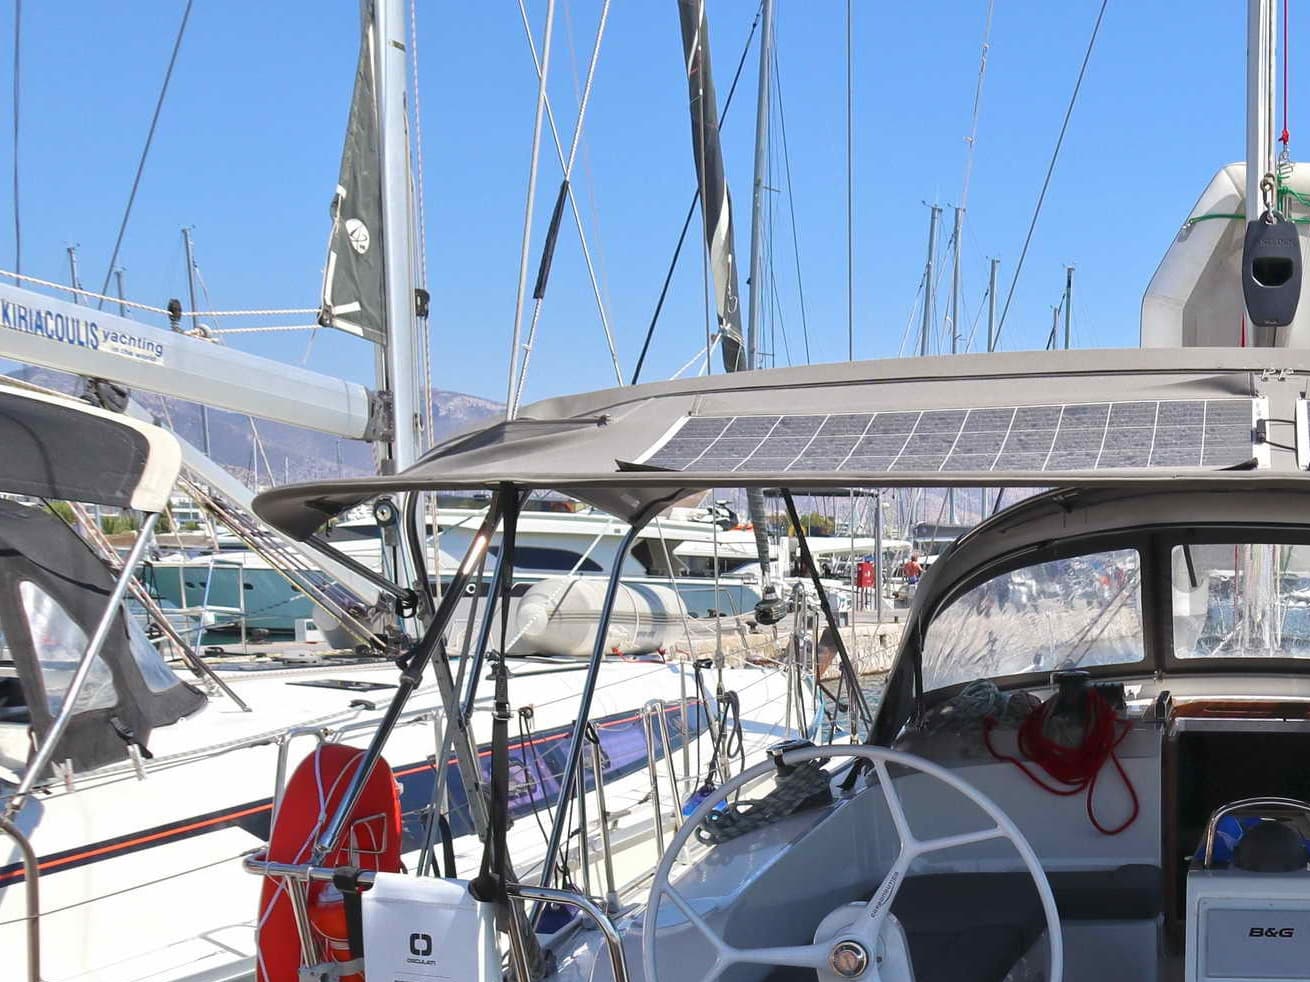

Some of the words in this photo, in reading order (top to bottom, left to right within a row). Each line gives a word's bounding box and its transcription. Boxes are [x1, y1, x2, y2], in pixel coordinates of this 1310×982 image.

[1, 302, 99, 350] KIRIACOULIS
[102, 328, 164, 358] yachting
[1249, 927, 1295, 938] B&G
